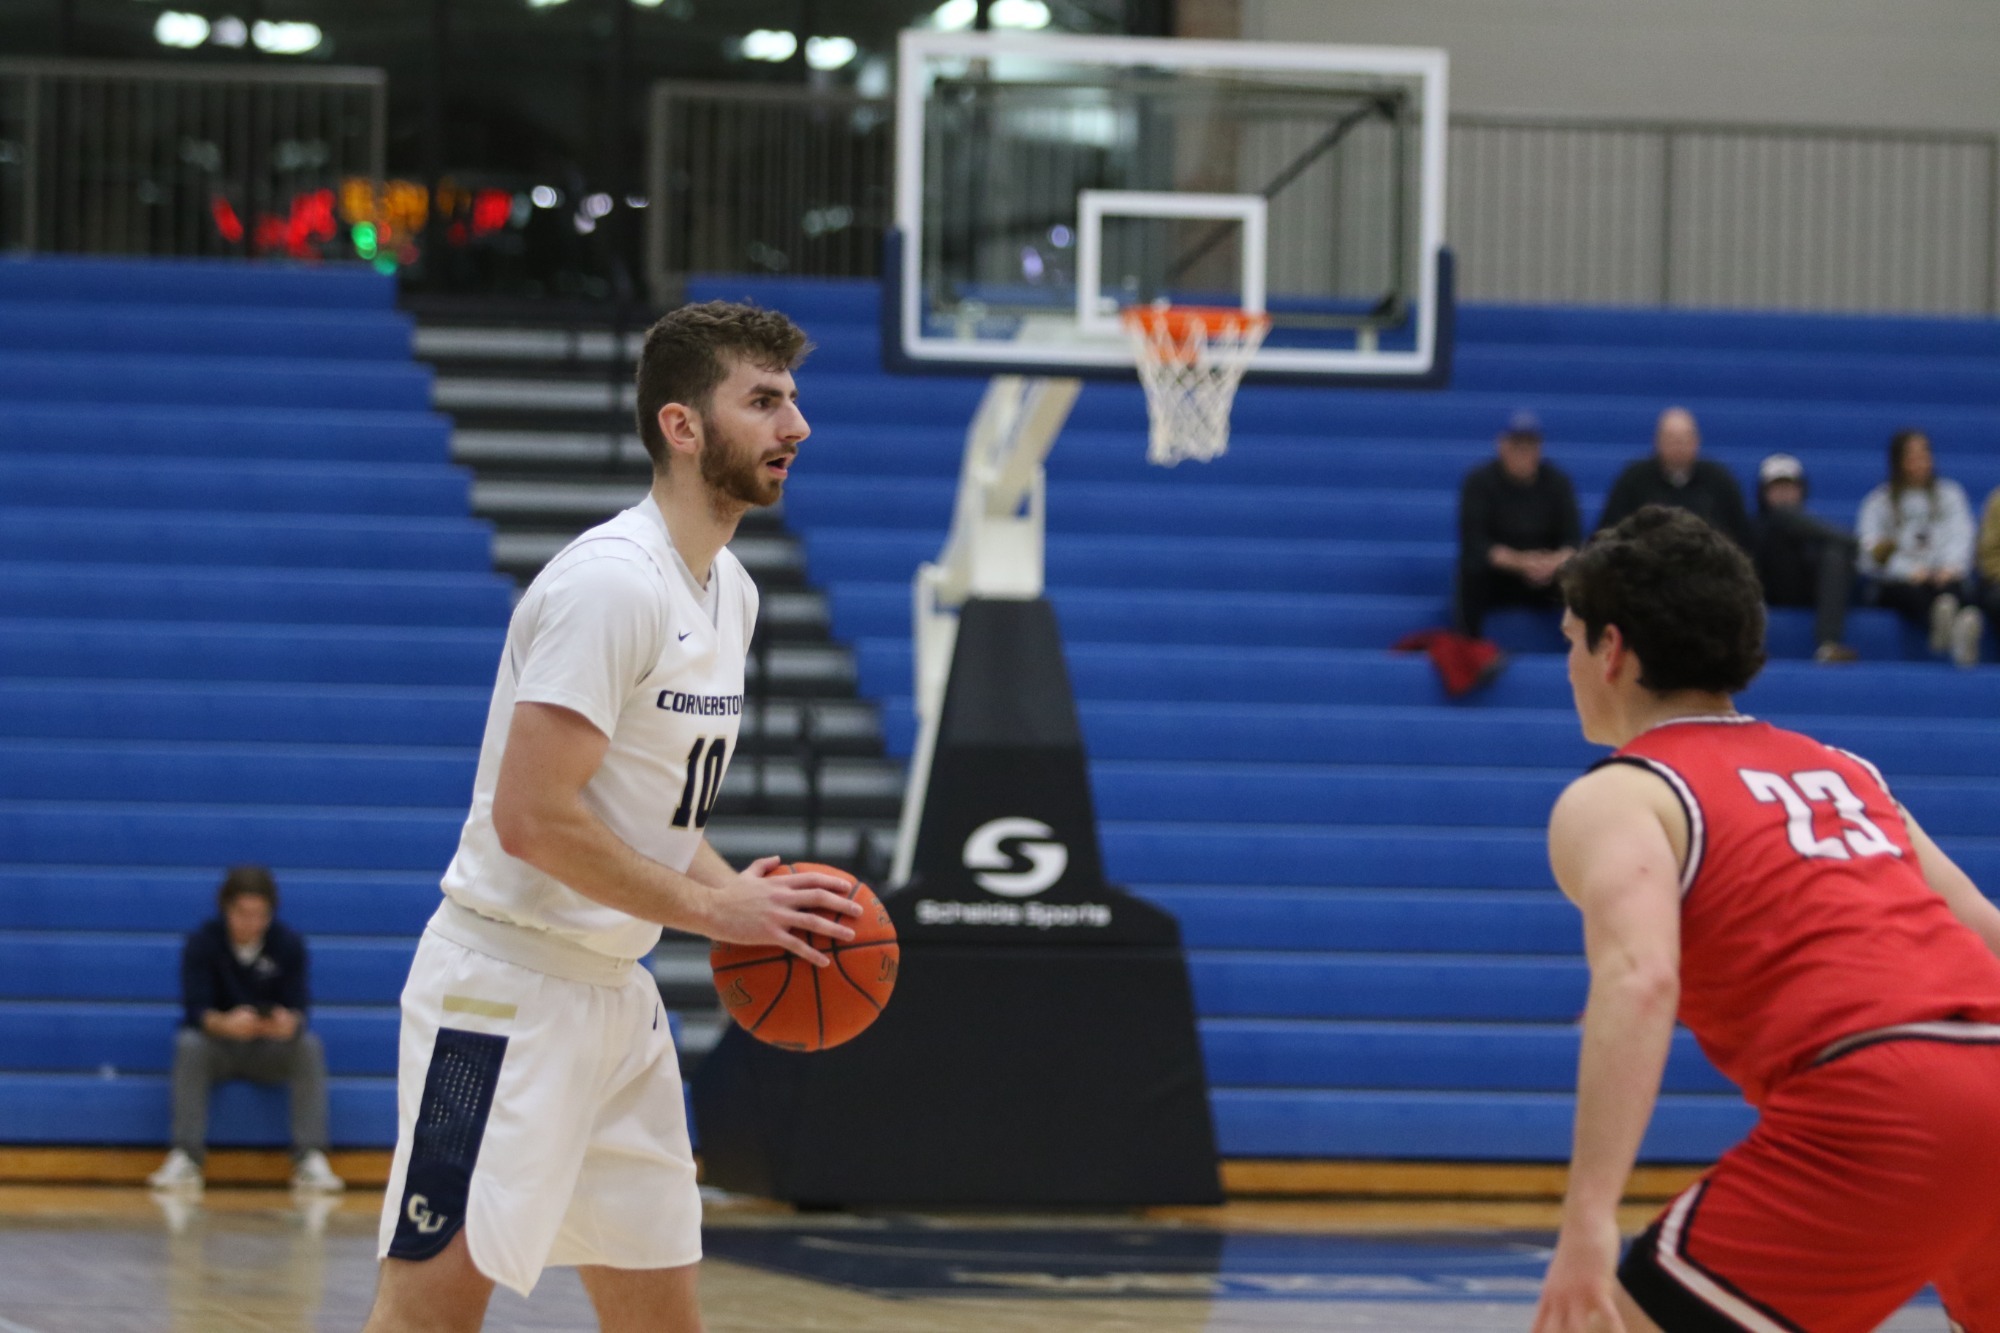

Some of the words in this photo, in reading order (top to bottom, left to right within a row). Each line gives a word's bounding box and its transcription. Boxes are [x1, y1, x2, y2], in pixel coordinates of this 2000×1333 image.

[669, 735, 727, 831] 10
[1738, 768, 1903, 860] 23
[1024, 902, 1111, 930] Sports
[407, 1192, 448, 1234] CU
